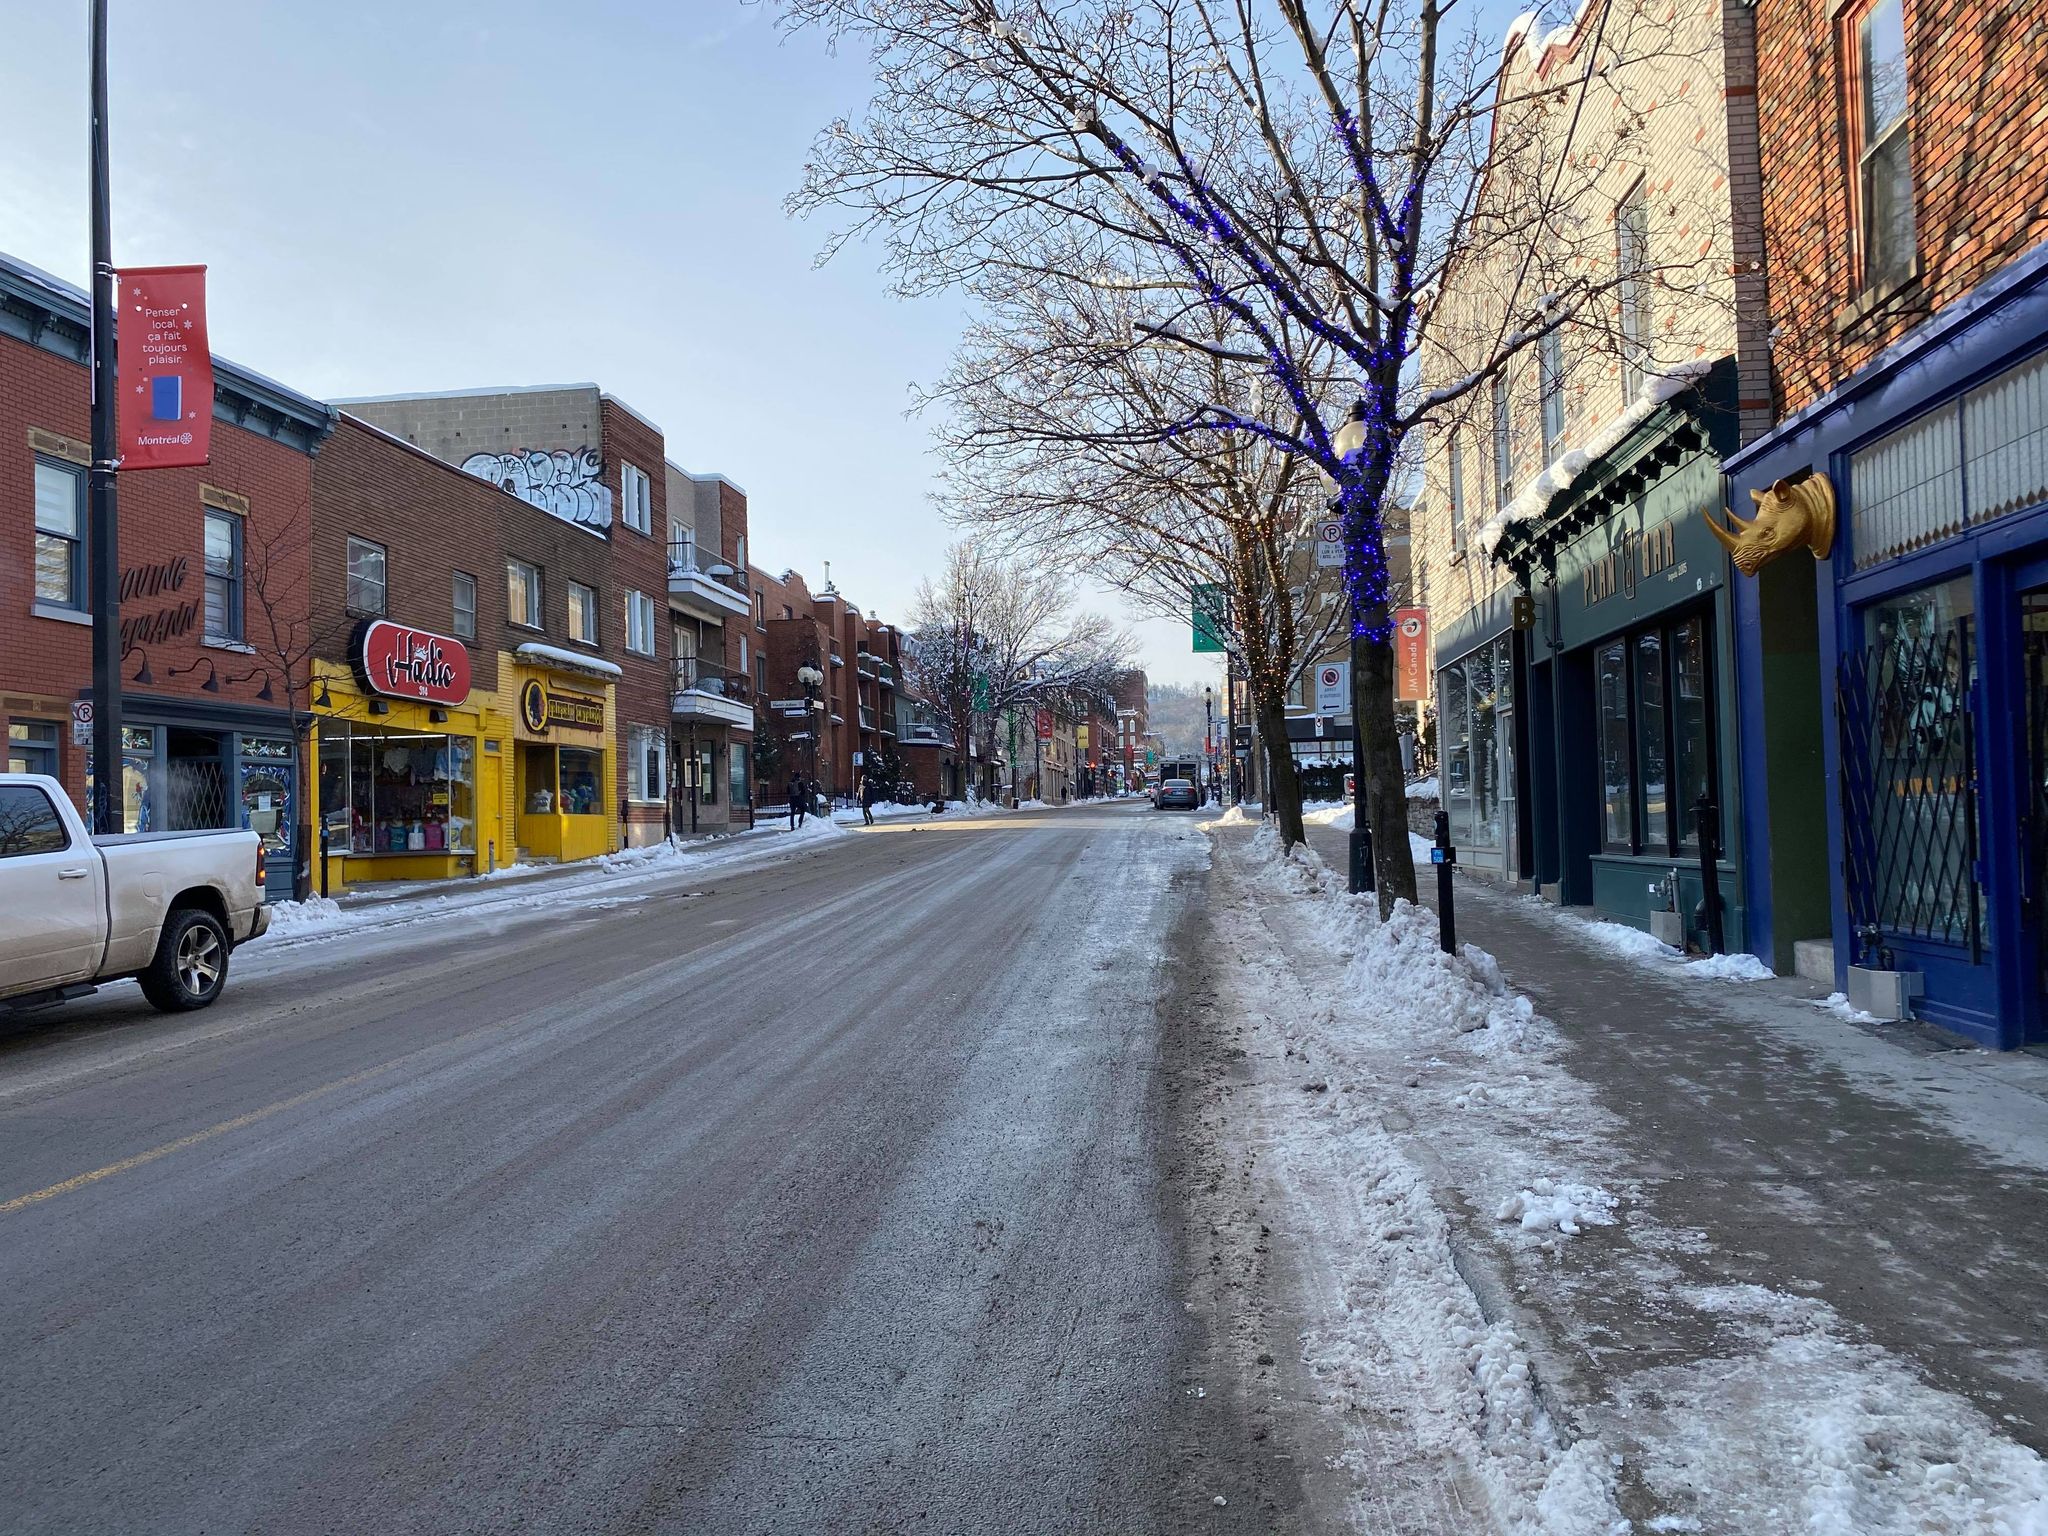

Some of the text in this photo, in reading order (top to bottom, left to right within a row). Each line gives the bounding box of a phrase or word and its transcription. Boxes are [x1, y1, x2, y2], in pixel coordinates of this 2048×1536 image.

[145, 308, 181, 318] Penser
[152, 319, 179, 330] local,
[147, 331, 182, 343] ça fait
[142, 344, 188, 355] toujours
[138, 435, 180, 446] Montréal
[1583, 551, 1617, 608] PLAN
[1641, 520, 1675, 578] BAR
[1512, 596, 1537, 631] B
[386, 631, 456, 689] Hadio
[1408, 641, 1418, 694] JM Canada
